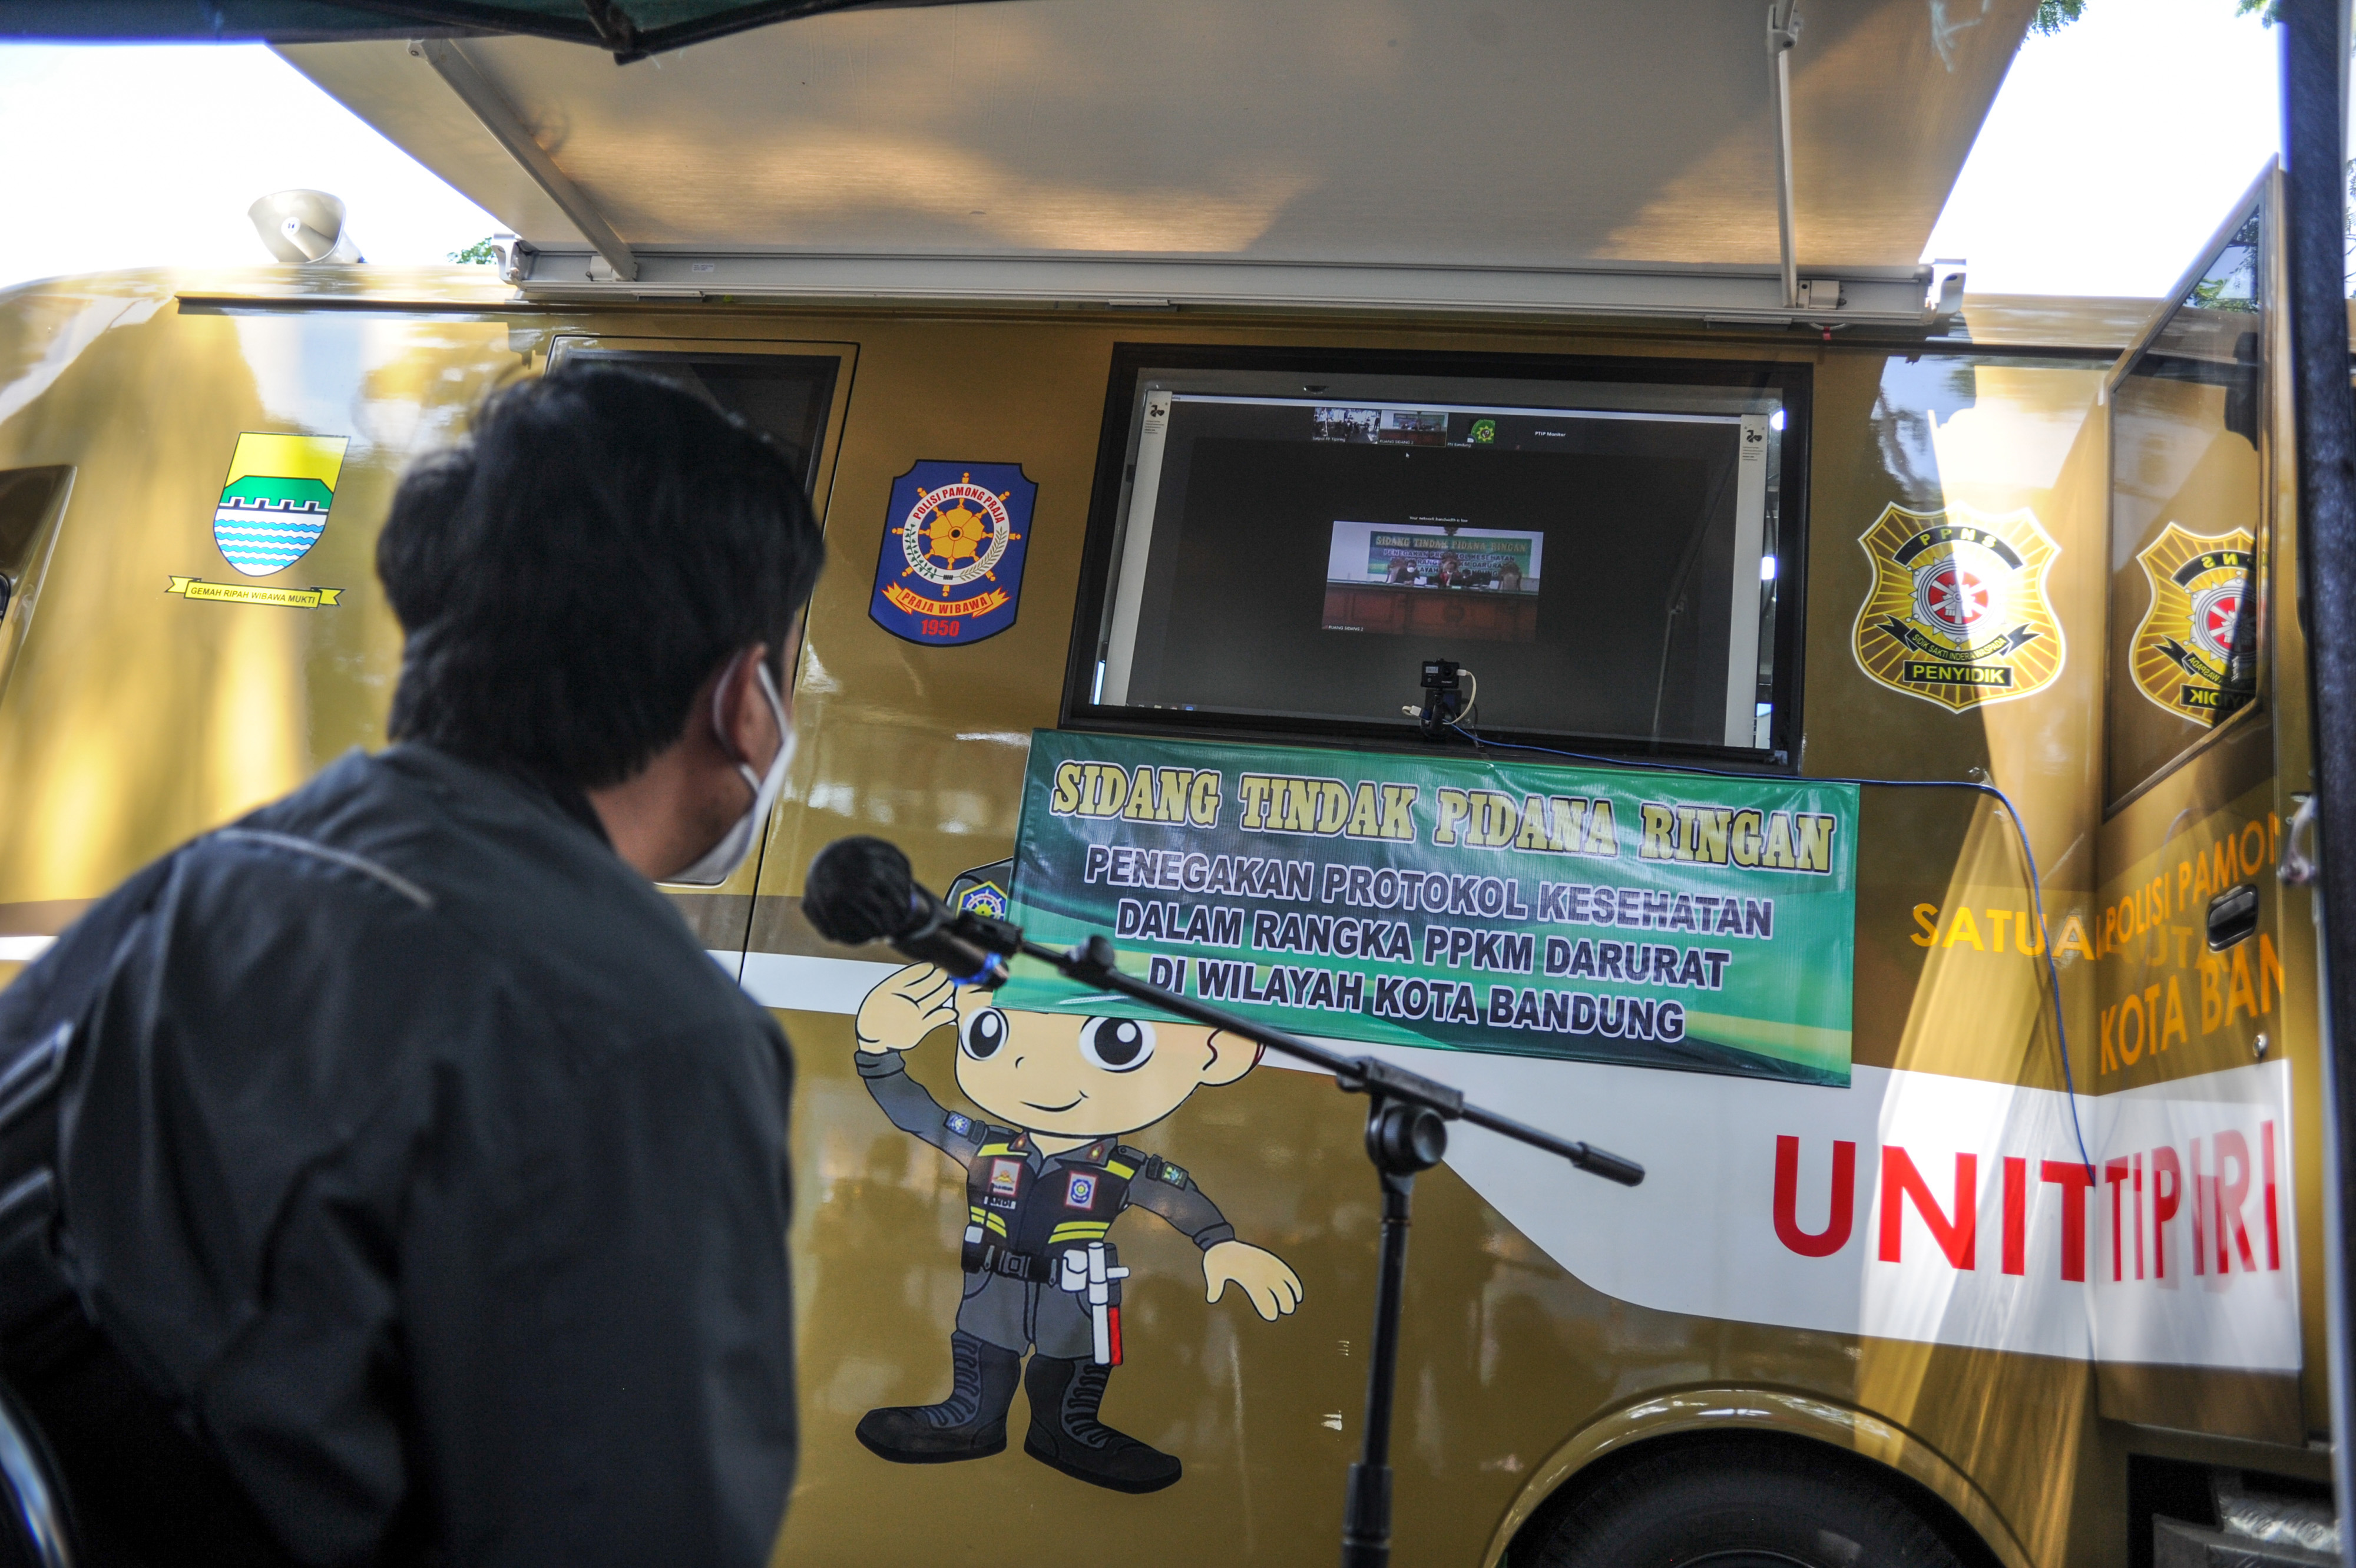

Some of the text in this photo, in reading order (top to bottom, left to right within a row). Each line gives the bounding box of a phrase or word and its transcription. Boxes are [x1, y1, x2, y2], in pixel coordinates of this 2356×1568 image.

[913, 487, 1005, 524] POLISI PAMONG PRAJA
[1375, 536, 1527, 553] SIDANG TINDAK PIDANA RINGAN
[1384, 549, 1429, 558] PENEGAKAN
[1920, 528, 1997, 548] PPNS
[191, 587, 316, 604] GEMAH RIPAH WIBAWA MUKTI
[902, 593, 988, 614] PRAJA WIBAWA
[921, 619, 960, 637] 1950
[1912, 634, 2007, 661] SIDIK SAKTI INDERA WASPADA
[1914, 664, 2005, 683] PENYIDIK
[1051, 760, 1834, 874] SIDANG TINDAK PIDANA RINGAN
[1085, 845, 1773, 940] PENEGAKAN PROTOKOL KESEHATAN
[2106, 872, 2170, 952] POLISI
[1116, 898, 1731, 990] DALAM RANGKA PPKM DARURAT
[1149, 954, 1686, 1042] DI WILAYAH KOTA BANDUNG
[2101, 975, 2188, 1076] KOTA
[1773, 1134, 2096, 1283] UNIT
